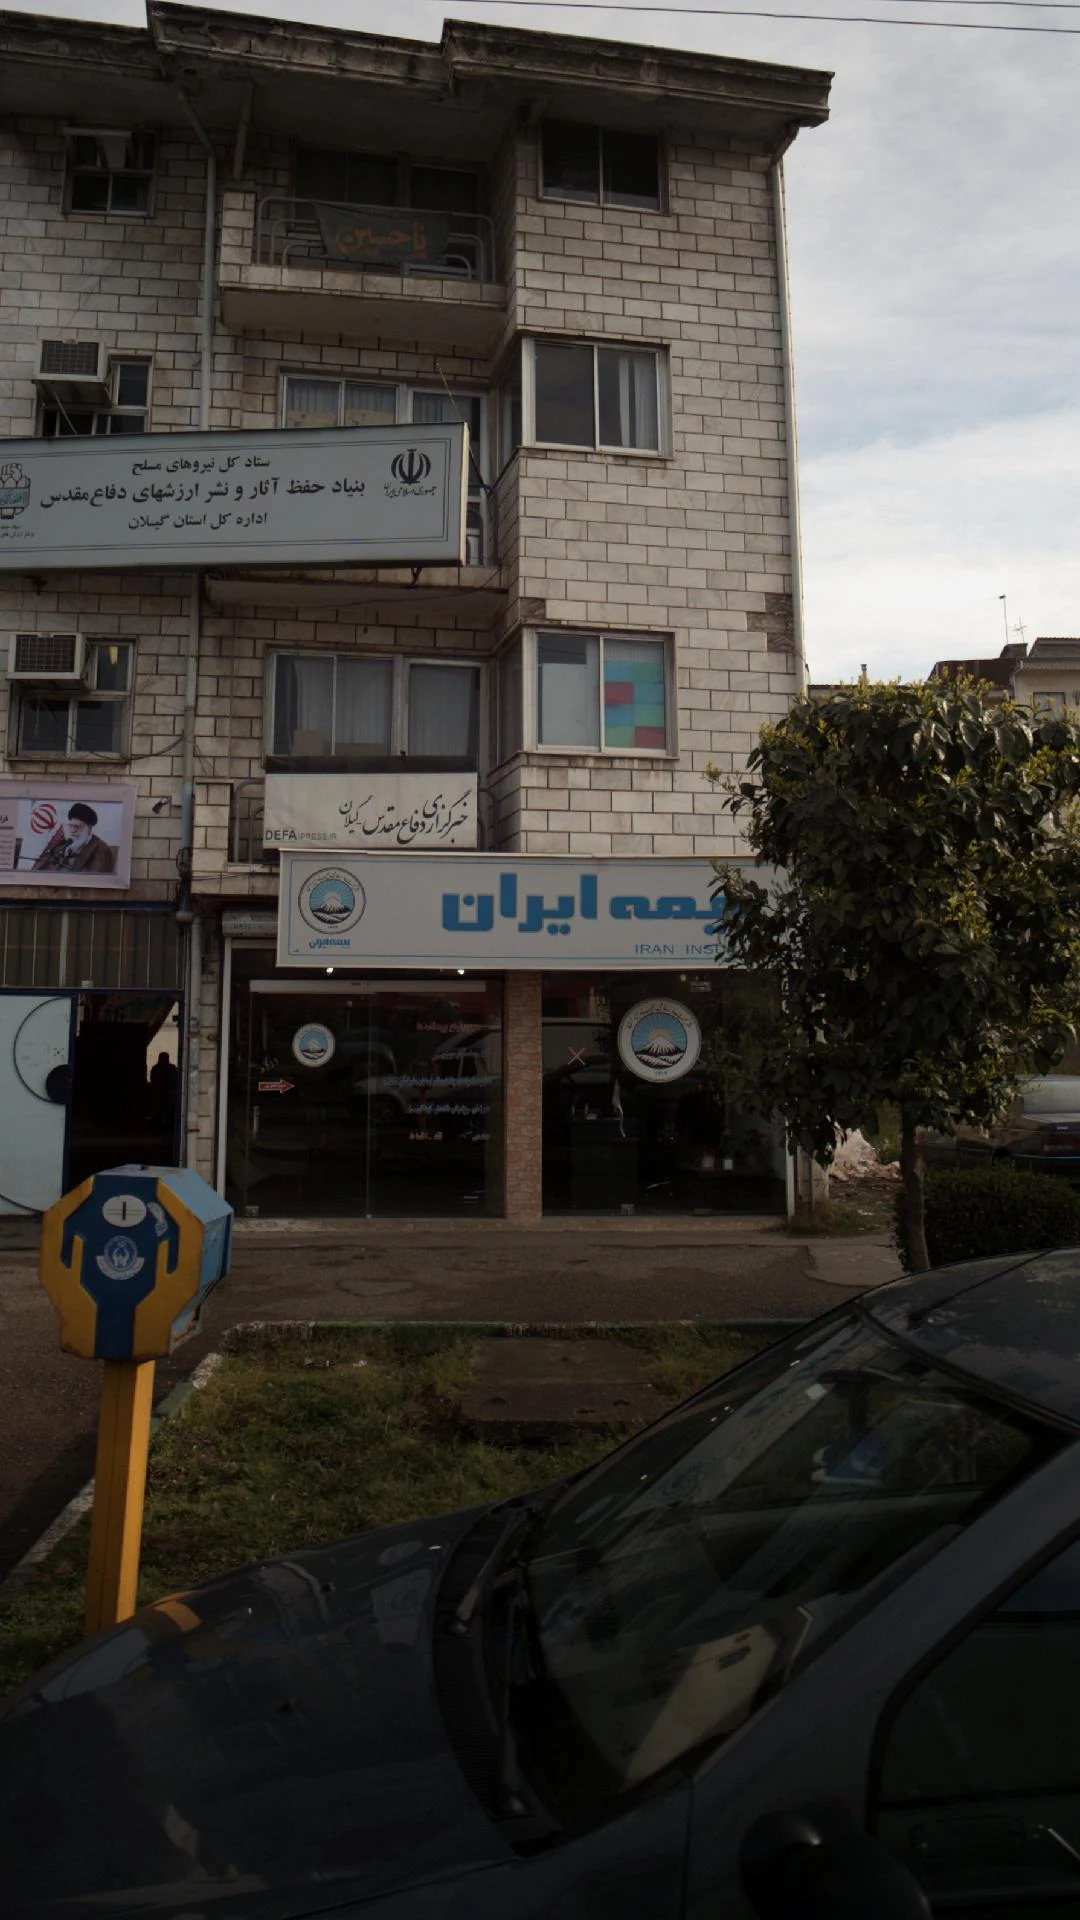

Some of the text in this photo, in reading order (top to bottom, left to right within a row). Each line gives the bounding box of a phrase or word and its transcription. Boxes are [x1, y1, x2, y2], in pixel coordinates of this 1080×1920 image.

[132, 455, 271, 475] ستاد کل نیروهای مسلح
[40, 486, 89, 508] مقدس
[133, 482, 199, 503] ارزشهای
[204, 481, 228, 503] نشر
[235, 486, 243, 501] و
[249, 477, 280, 500] آثار
[285, 479, 325, 495] حفظ
[331, 478, 365, 497] بنیاد
[128, 512, 268, 530] اداره کل استان گیلان
[362, 805, 400, 835] مقدس
[397, 809, 426, 844] دفاع
[265, 830, 298, 841] DEFA
[442, 872, 740, 936] یمه ایران
[634, 943, 730, 955] IRAN INSU
